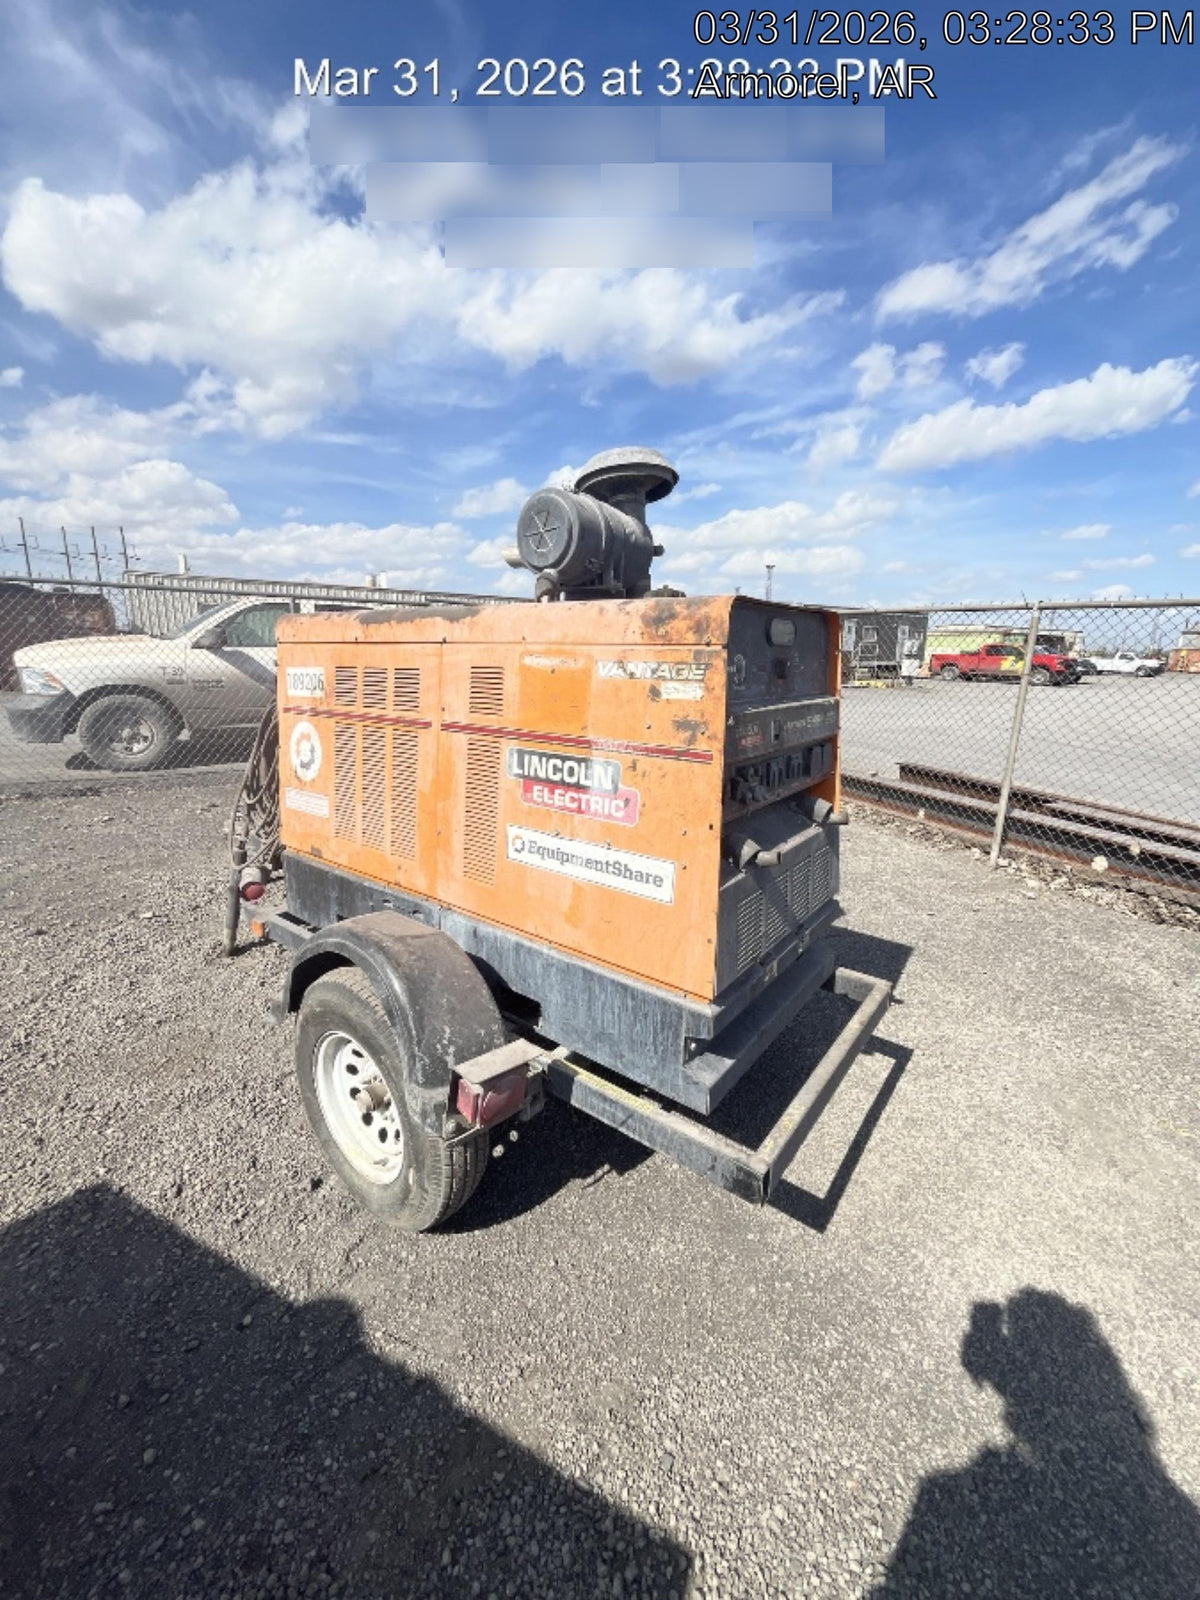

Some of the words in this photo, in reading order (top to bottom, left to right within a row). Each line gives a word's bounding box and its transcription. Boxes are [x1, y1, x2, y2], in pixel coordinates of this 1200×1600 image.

[596, 659, 709, 681] VANTAGE
[511, 752, 614, 790] LINCOLN
[532, 785, 626, 818] ELECTRIC
[527, 839, 665, 889] EquipmentShare
